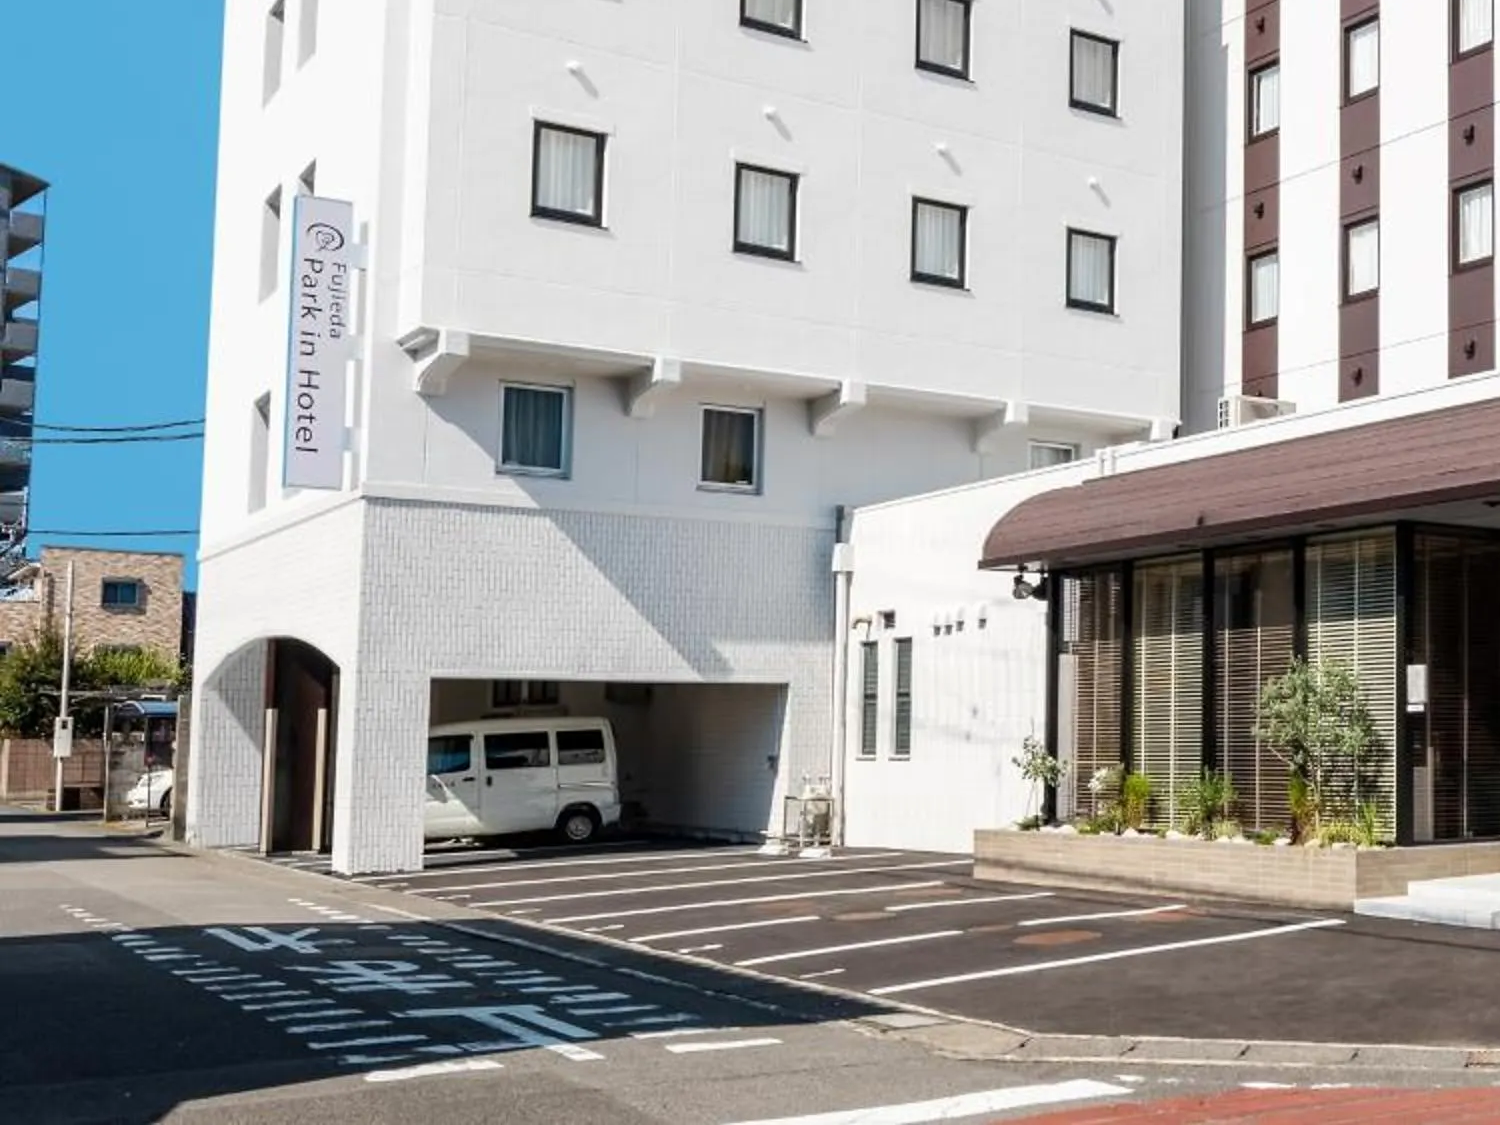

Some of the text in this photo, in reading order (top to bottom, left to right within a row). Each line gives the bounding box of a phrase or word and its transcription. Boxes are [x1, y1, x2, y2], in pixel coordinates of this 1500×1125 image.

[295, 258, 323, 453] Park in Hotel
[328, 262, 347, 339] Fujieda
